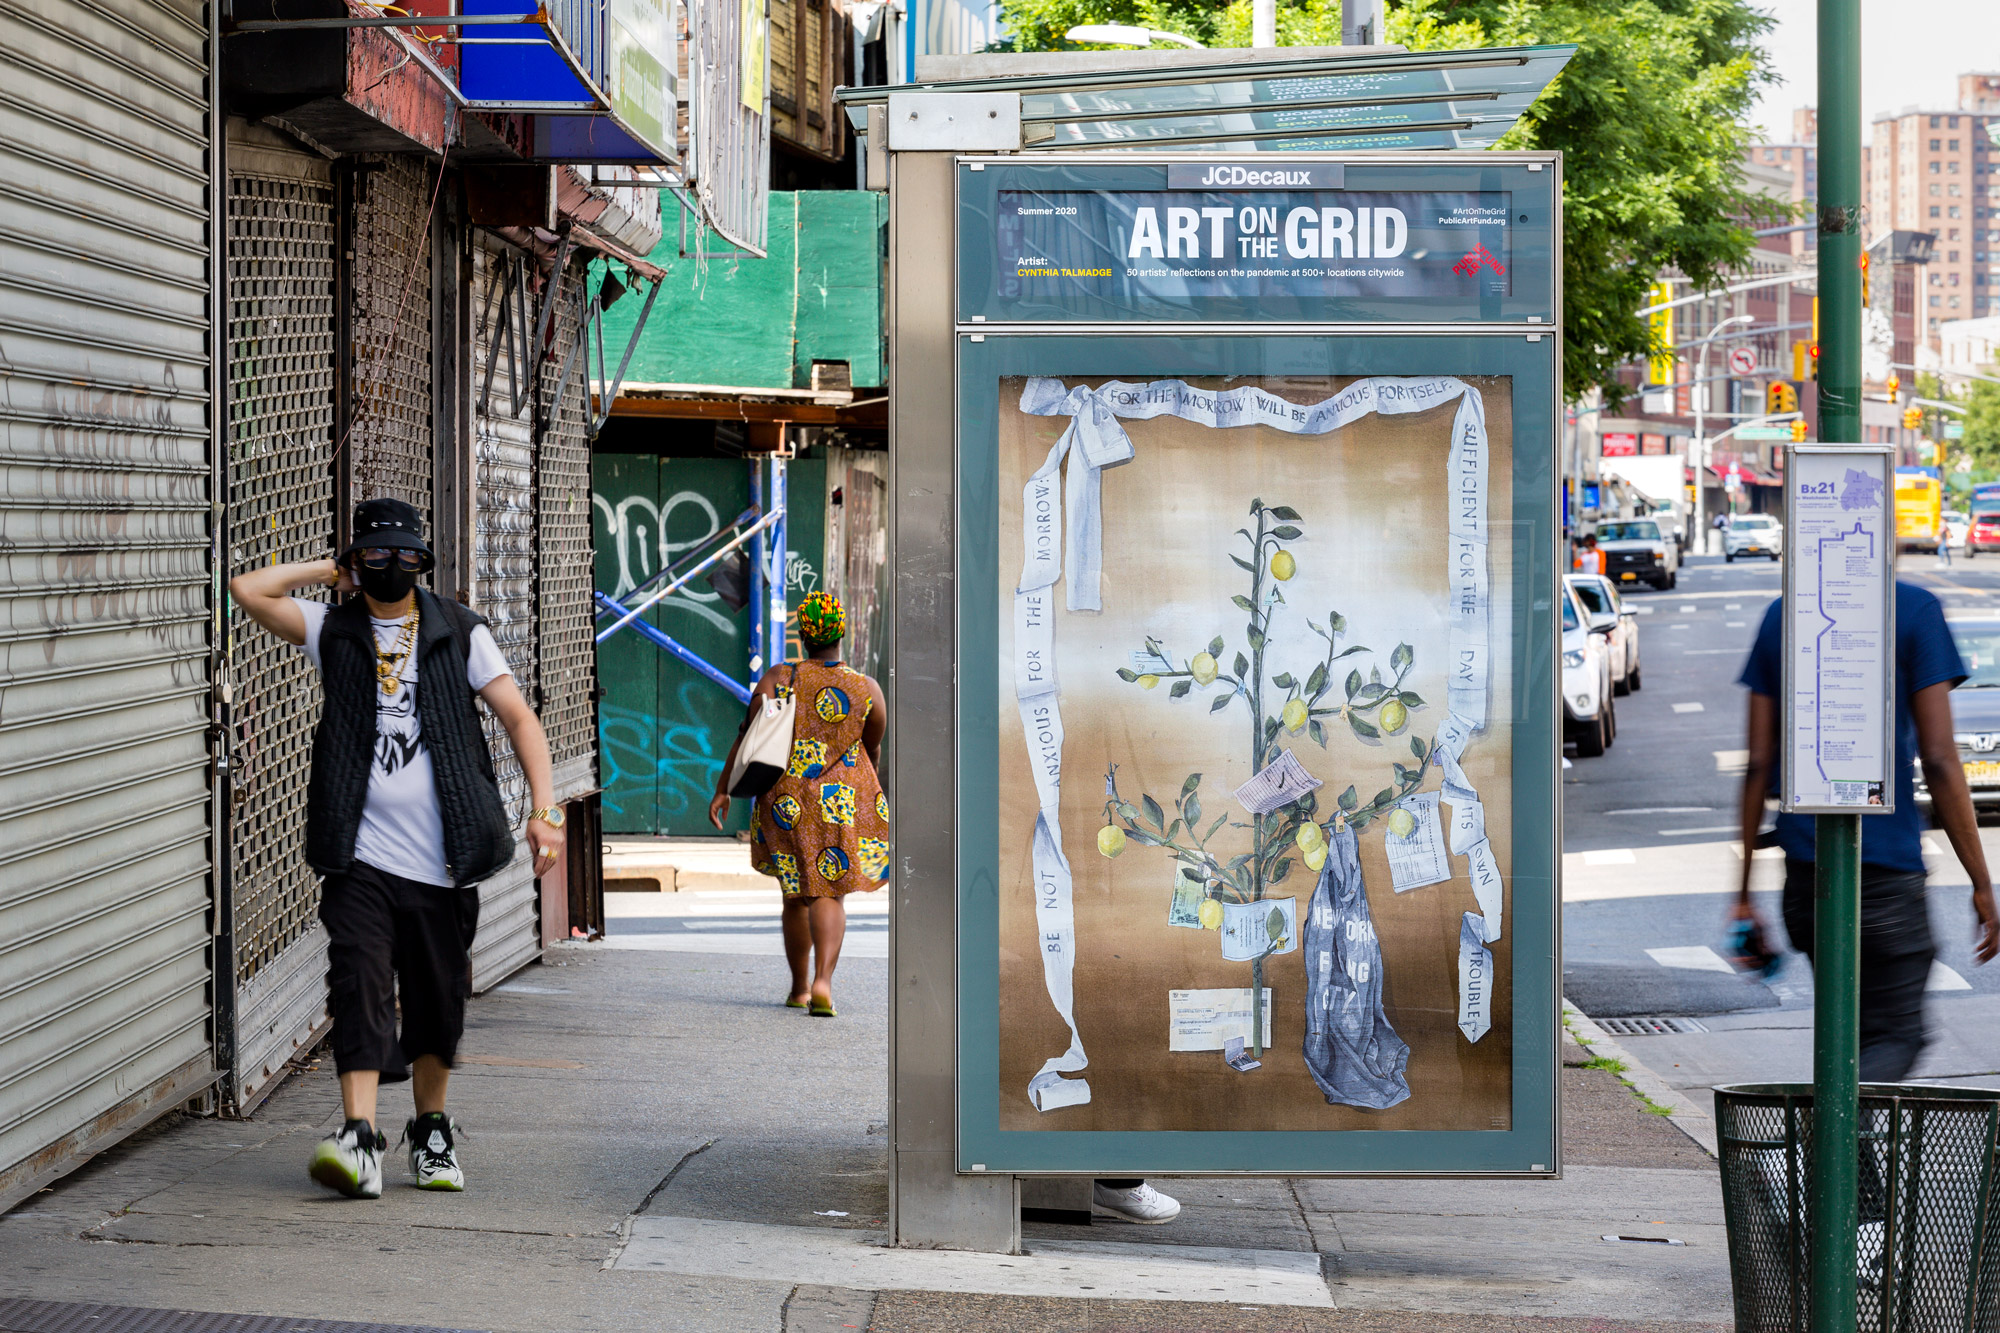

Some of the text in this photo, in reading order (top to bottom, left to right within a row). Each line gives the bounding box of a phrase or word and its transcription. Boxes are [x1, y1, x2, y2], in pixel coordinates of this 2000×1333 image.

[1201, 166, 1311, 186] JCDecaux
[1017, 207, 1077, 216] Summer 2020
[1438, 217, 1506, 226] PublicArtFund.org
[1452, 208, 1506, 216] #ArtOnTheGrid
[1128, 206, 1408, 259] ART ON THE GRID
[1017, 257, 1048, 266] Artist:
[1452, 242, 1486, 276] PUBLIC
[1466, 255, 1486, 278] ART
[1480, 249, 1506, 276] FUND
[1017, 268, 1112, 277] CYNTHIA TALMADGE
[1126, 268, 1138, 277] 50
[1170, 268, 1215, 277] reflections
[1230, 268, 1244, 277] the
[1247, 268, 1287, 279] pandemic
[1288, 269, 1300, 277] at
[1302, 268, 1325, 277] 500+
[1327, 268, 1366, 277] locations
[1368, 268, 1404, 279] citywide
[1110, 390, 1141, 405] FOR
[1145, 388, 1173, 404] THE
[1179, 391, 1246, 414] MORROW
[1255, 395, 1287, 417] WILL
[1291, 409, 1306, 424] BE
[1315, 386, 1371, 423] ANXIOUS
[1801, 482, 1835, 494] Bx21
[1459, 422, 1478, 683] SUFFICIENT FOR THE DAY
[1026, 596, 1041, 628] THE
[1027, 650, 1043, 682] FOR
[1034, 707, 1061, 788] ANXIOUS
[1445, 725, 1494, 1018] IS ITS OWN TROUBLE
[1041, 870, 1058, 909] NOT
[1047, 932, 1061, 953] BE
